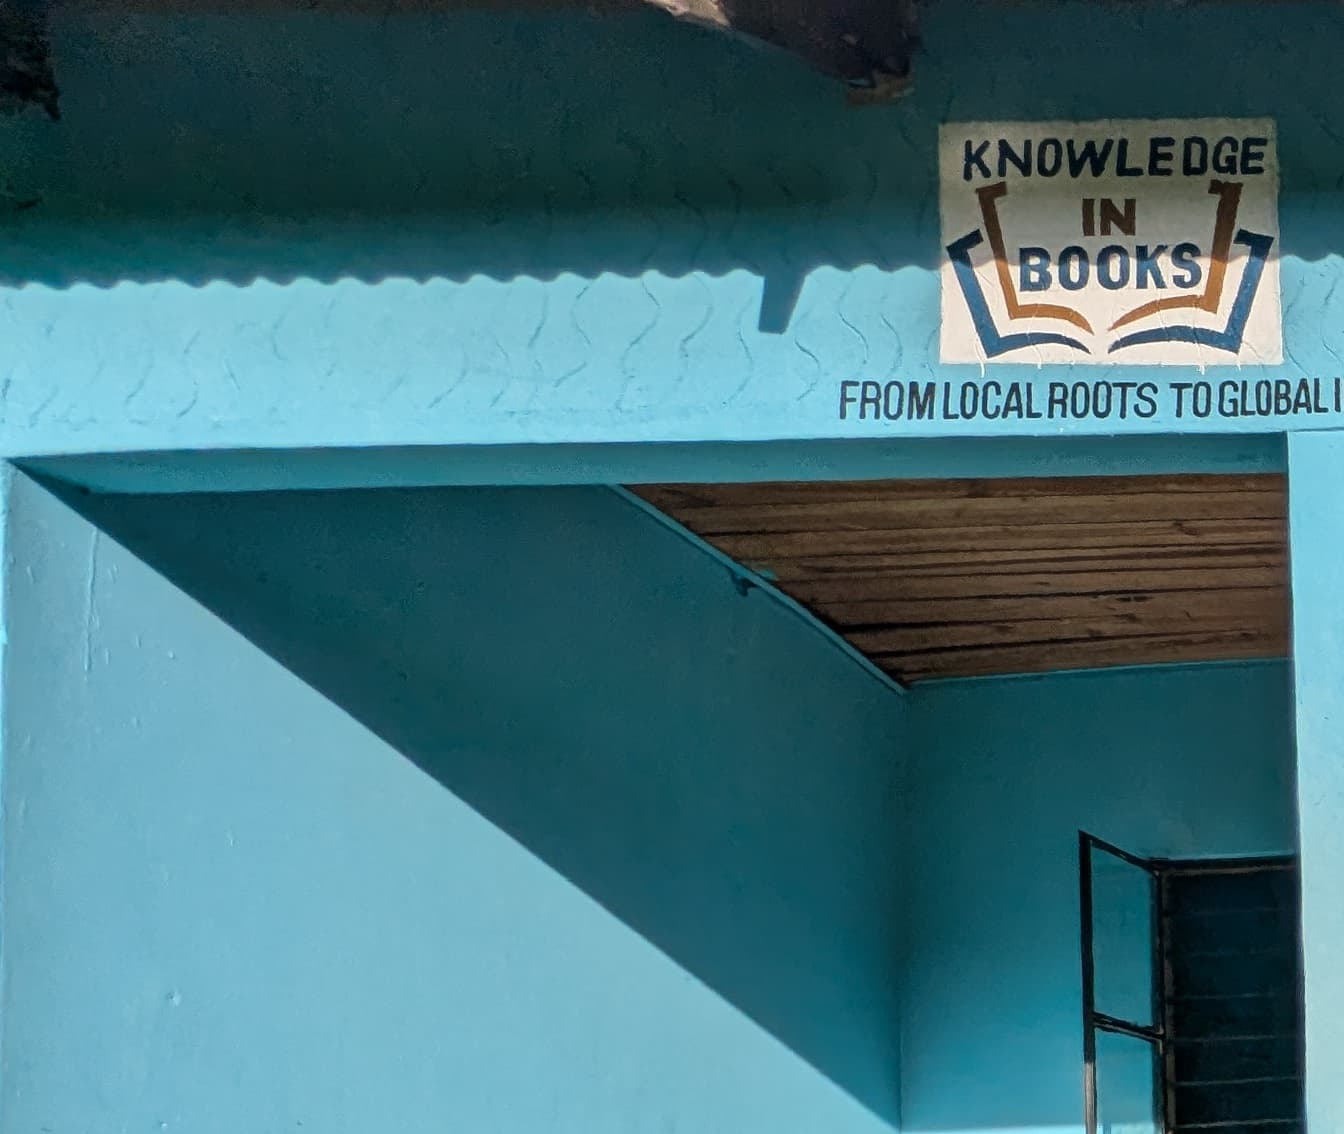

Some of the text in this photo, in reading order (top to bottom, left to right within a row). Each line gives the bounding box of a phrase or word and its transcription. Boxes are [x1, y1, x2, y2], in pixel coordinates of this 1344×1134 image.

[963, 135, 1268, 182] KNOWLEDGE
[1081, 197, 1137, 237] IN
[1018, 242, 1202, 293] BOOKS
[839, 379, 937, 421] FROM
[942, 380, 1043, 421] LOCAL
[1047, 380, 1159, 420] ROOTS
[1169, 381, 1212, 419] TO
[1217, 376, 1329, 418] GLOBAL
